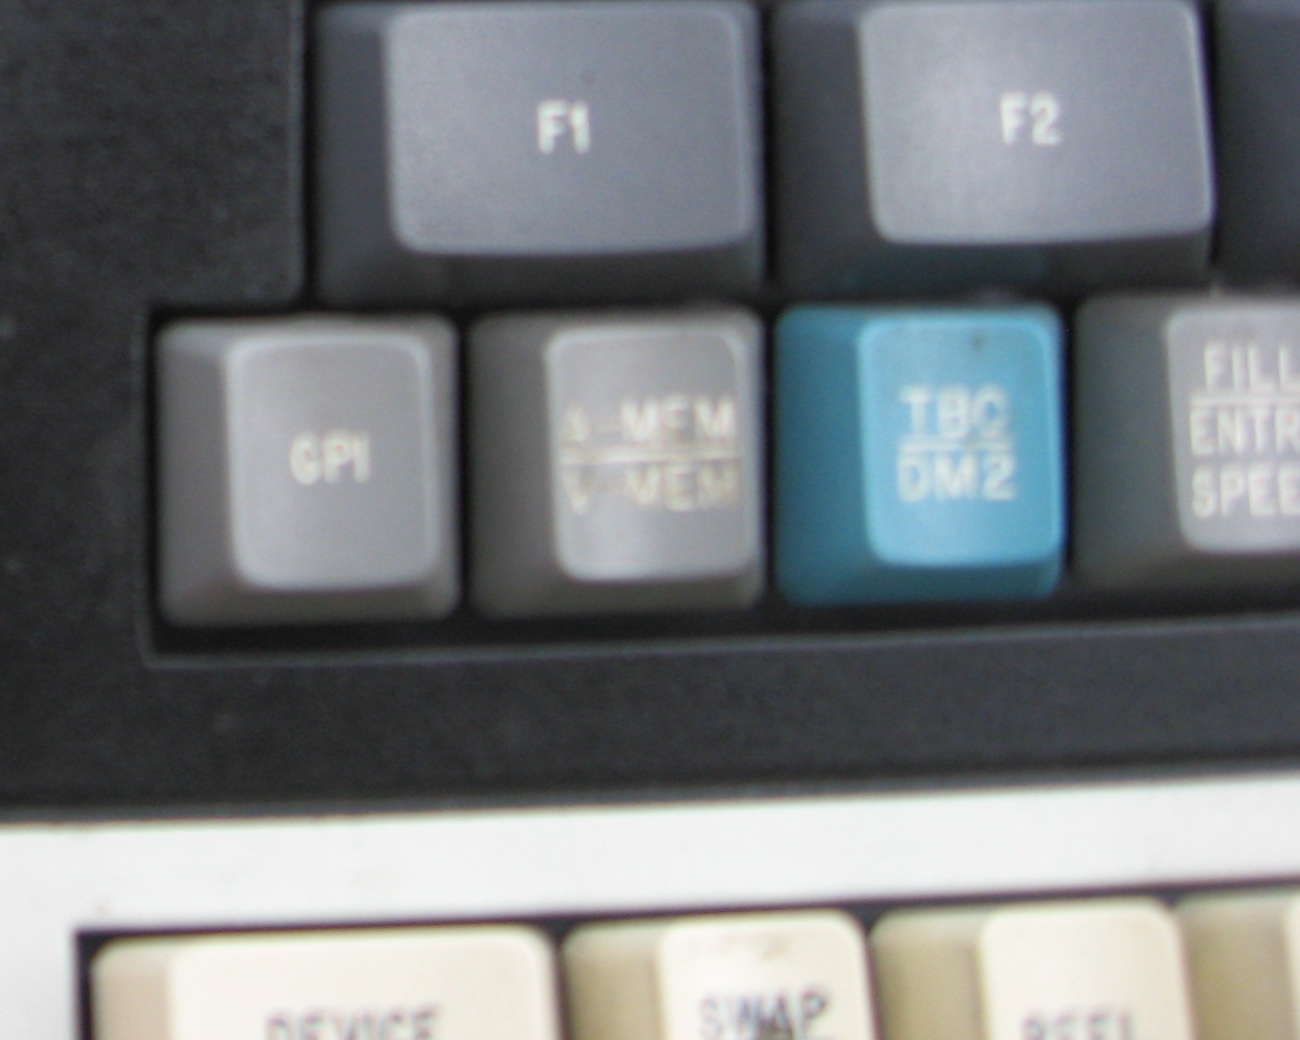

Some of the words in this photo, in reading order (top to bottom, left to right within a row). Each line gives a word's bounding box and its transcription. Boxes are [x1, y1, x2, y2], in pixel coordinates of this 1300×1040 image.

[536, 98, 591, 154] F1
[999, 91, 1063, 147] F2
[1204, 342, 1300, 392] FILL
[289, 429, 370, 485] GPI
[897, 450, 1018, 501] DM2
